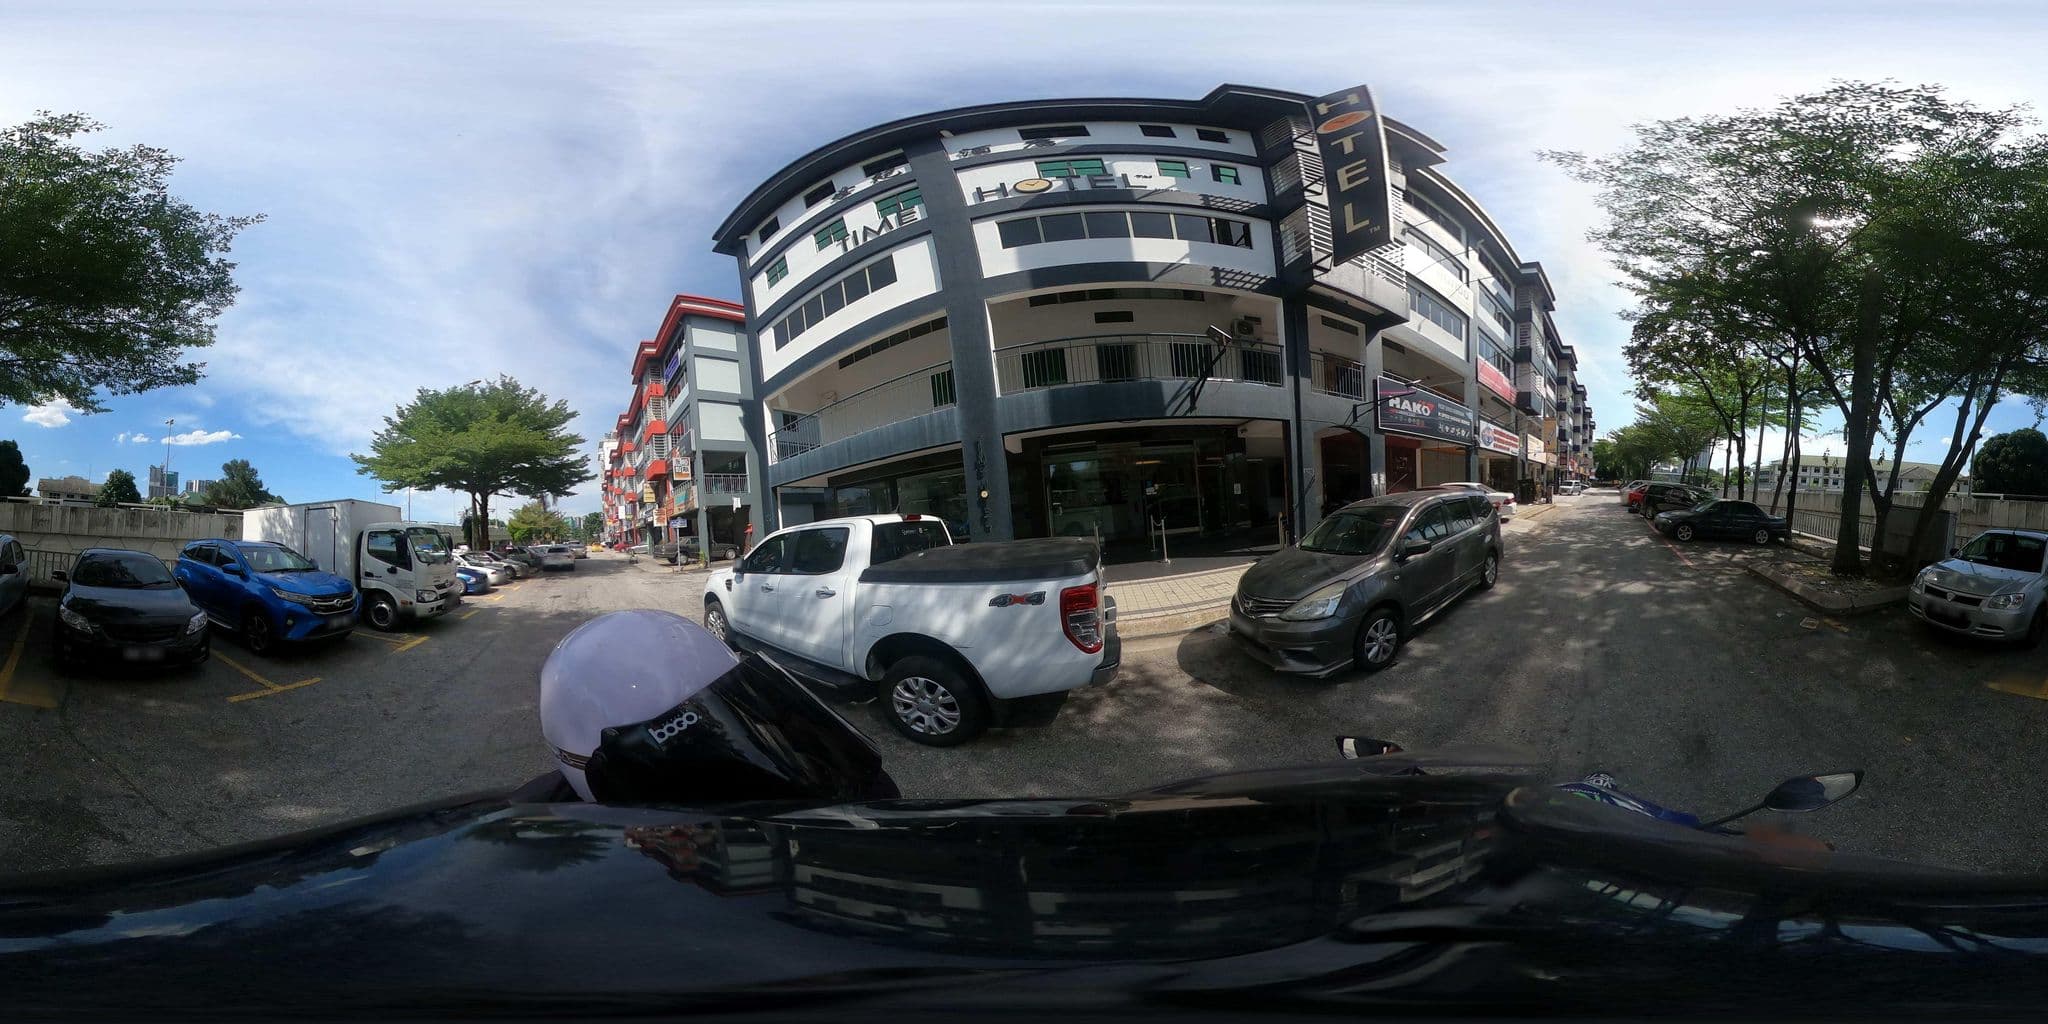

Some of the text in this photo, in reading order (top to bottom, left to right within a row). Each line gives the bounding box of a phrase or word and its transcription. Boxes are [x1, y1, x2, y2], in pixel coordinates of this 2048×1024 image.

[1316, 93, 1373, 234] HOTEL
[834, 205, 919, 252] TIME
[975, 173, 1148, 202] HOTEL
[1388, 395, 1431, 417] HAKO
